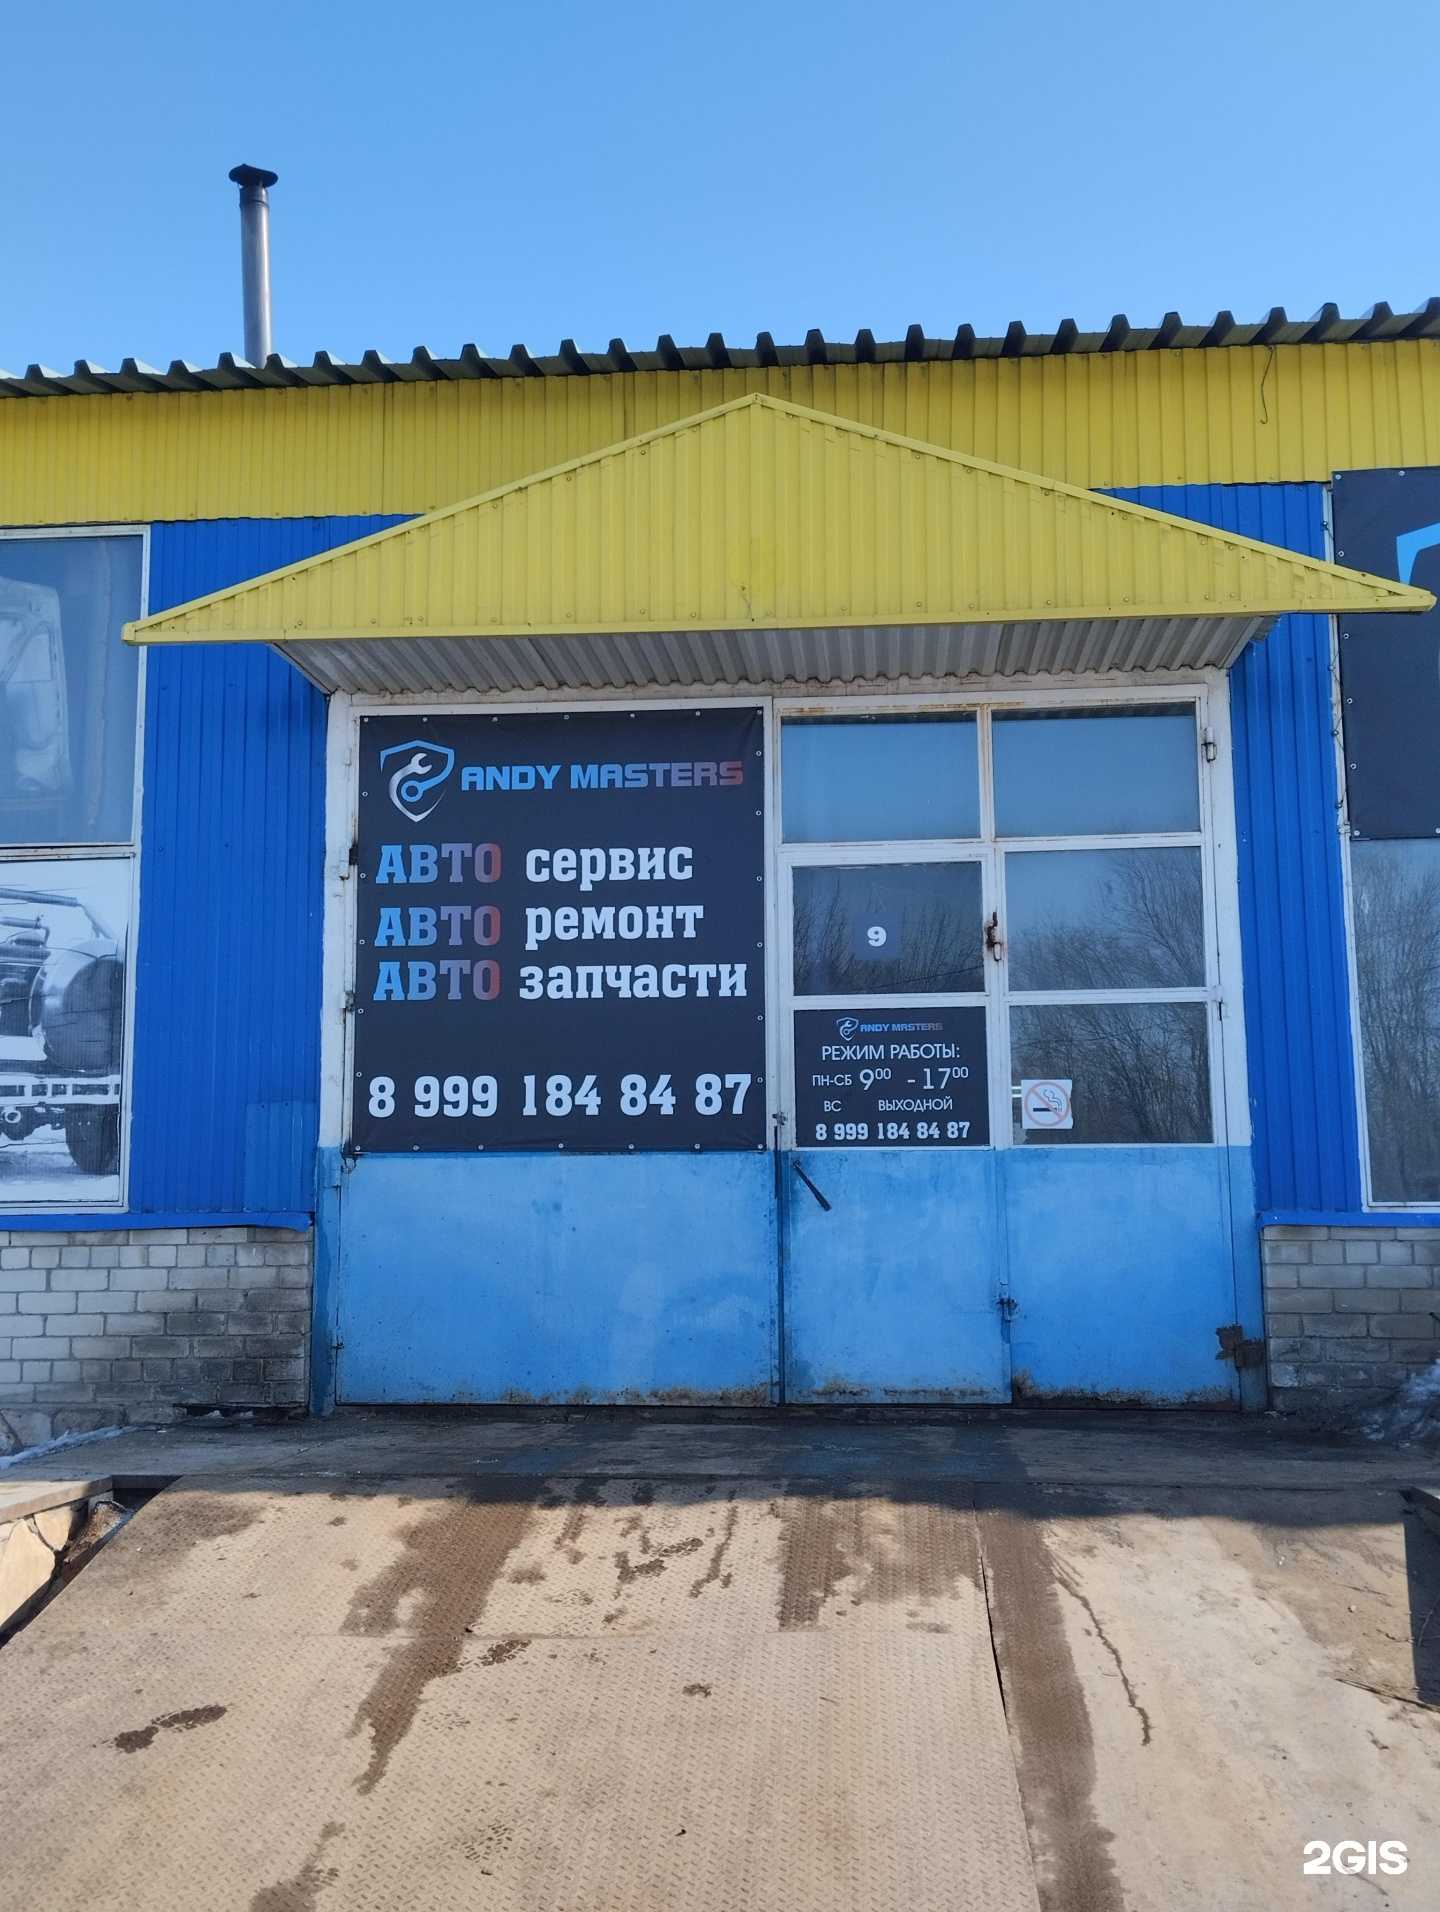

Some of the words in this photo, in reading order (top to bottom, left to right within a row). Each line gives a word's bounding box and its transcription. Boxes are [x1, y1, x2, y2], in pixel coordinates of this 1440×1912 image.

[461, 764, 560, 791] ANDY
[570, 761, 744, 790] MASTERS
[376, 842, 502, 885] АВТО
[526, 846, 693, 891] сервис
[374, 904, 502, 947] АВТО
[525, 905, 704, 950] ремонт
[867, 926, 887, 947] 9
[373, 960, 500, 1001] АВТО
[519, 963, 747, 999] запчасти
[860, 1023, 889, 1032] ANDY
[892, 1022, 943, 1032] MASTERS
[822, 1045, 885, 1061] РЕЖИМ
[890, 1044, 960, 1060] РАБОТЫ:
[813, 1073, 852, 1087] ПН-СБ
[368, 1076, 395, 1117] 8
[414, 1076, 498, 1117] 999
[522, 1075, 601, 1116] 184
[620, 1074, 676, 1116] 84
[695, 1073, 751, 1115] 87
[824, 1100, 841, 1112] ВС
[878, 1096, 952, 1113] ВЫХОДНОЙ
[816, 1124, 827, 1140] 8
[834, 1124, 868, 1140] 999
[877, 1122, 910, 1139] 184
[917, 1122, 940, 1139] 84
[947, 1122, 970, 1139] 87
